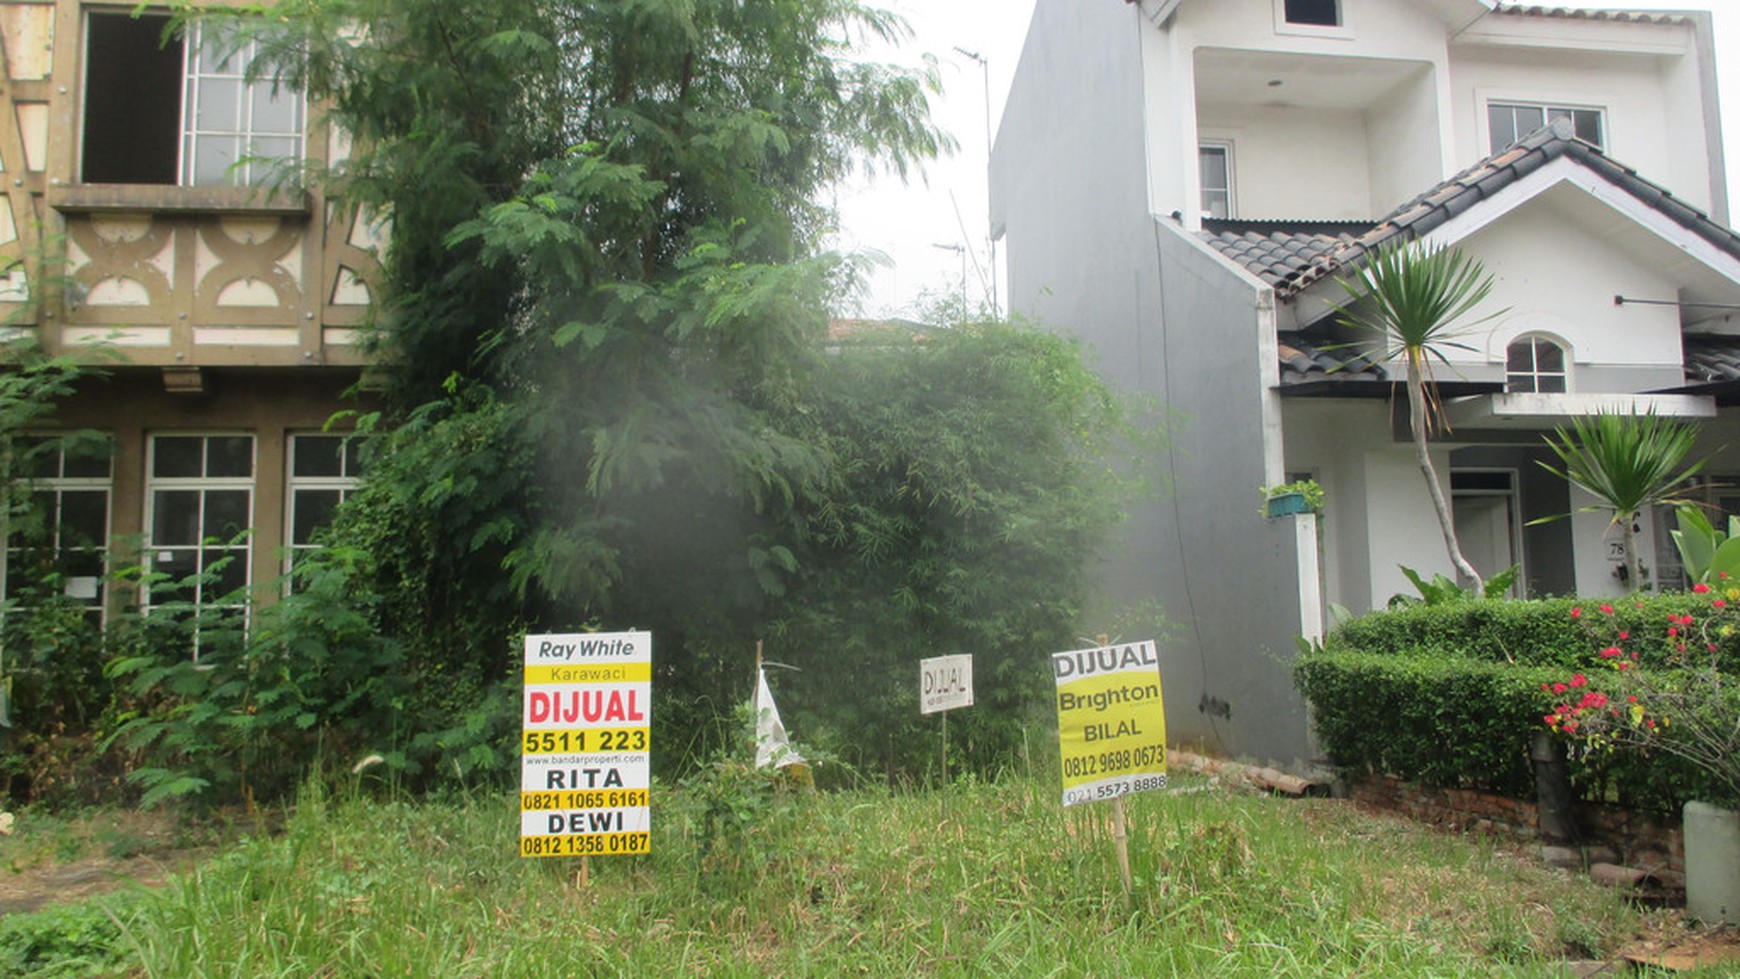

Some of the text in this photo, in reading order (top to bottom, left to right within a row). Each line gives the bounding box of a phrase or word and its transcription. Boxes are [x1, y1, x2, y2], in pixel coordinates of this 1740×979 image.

[539, 640, 635, 660] Ray White
[1053, 644, 1156, 678] DIJUAL
[551, 667, 626, 681] Karawaci
[529, 690, 644, 723] DIJUAL
[1060, 684, 1159, 711] Brighton
[526, 730, 646, 752] 5511 223
[1084, 719, 1142, 742] BILAL
[526, 754, 645, 766] www.bandarproperti.com
[1064, 744, 1164, 778] 0812 9698 0673
[547, 768, 624, 789] RITA
[1067, 775, 1167, 804] 021 5573 8888
[524, 791, 646, 809] 0821 1065 6161
[548, 812, 624, 834] DEWI
[524, 834, 648, 854] 0812 1358 0187
